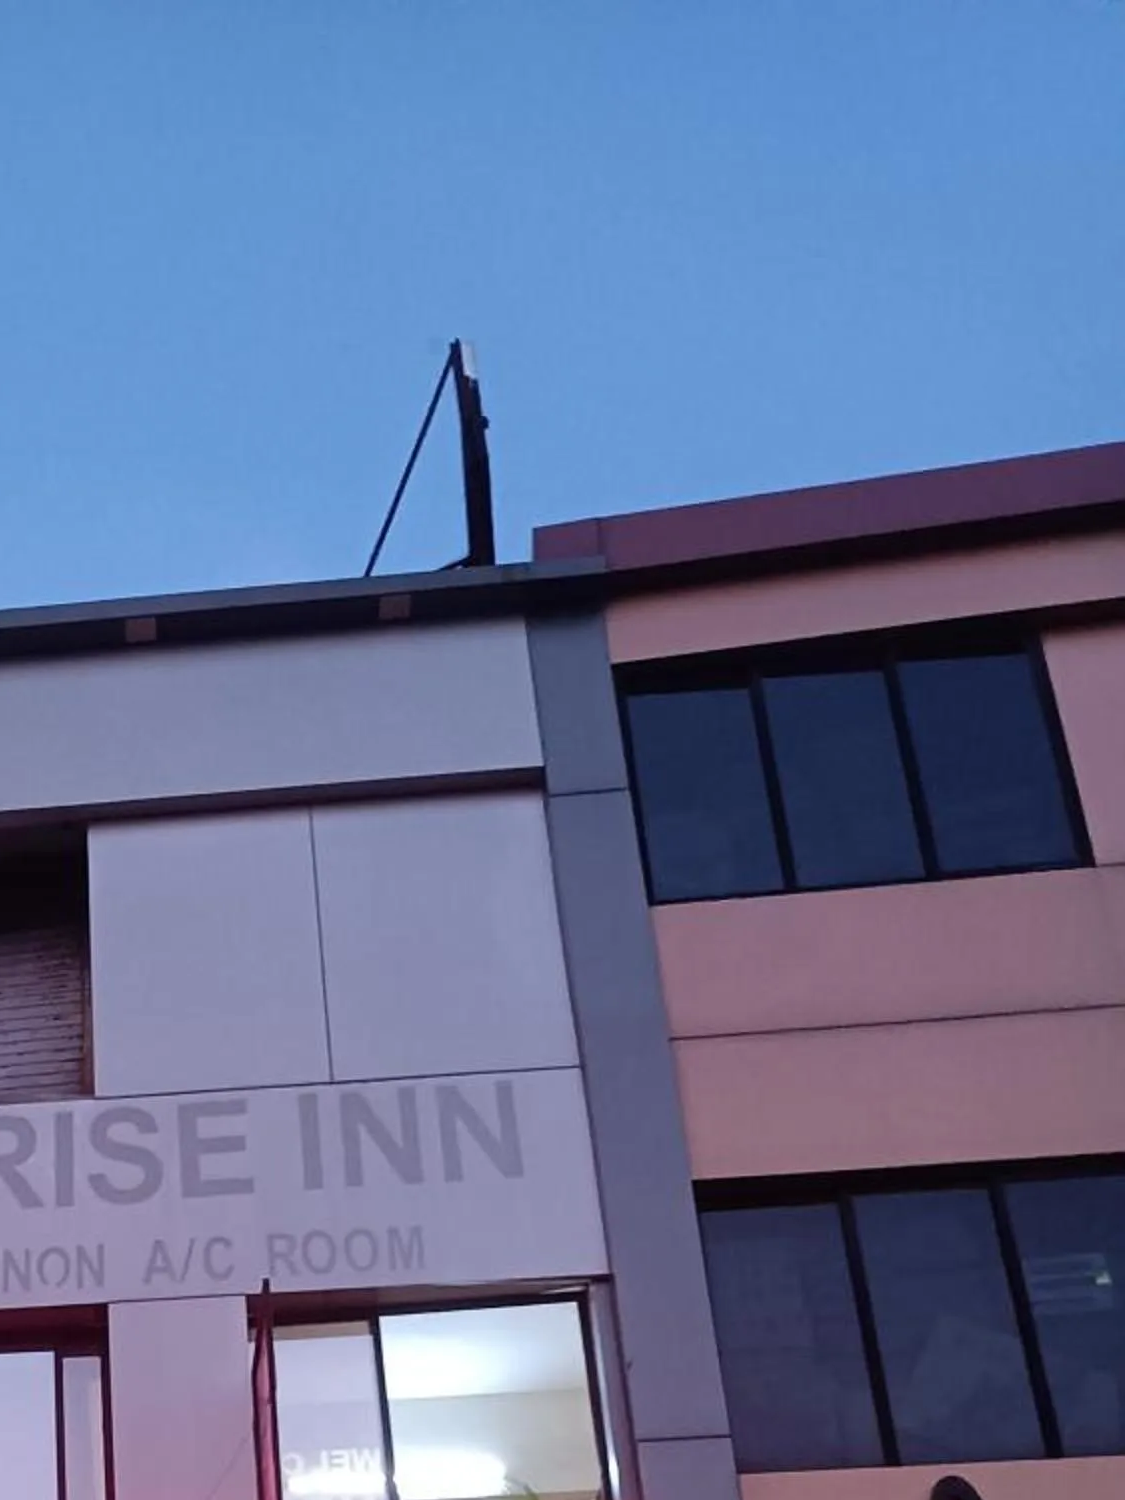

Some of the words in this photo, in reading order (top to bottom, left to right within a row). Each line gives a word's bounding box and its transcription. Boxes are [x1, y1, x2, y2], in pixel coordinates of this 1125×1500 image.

[297, 1079, 525, 1191] INN
[2, 1243, 106, 1293] NON
[141, 1234, 237, 1286] A/C
[266, 1225, 426, 1277] ROOM
